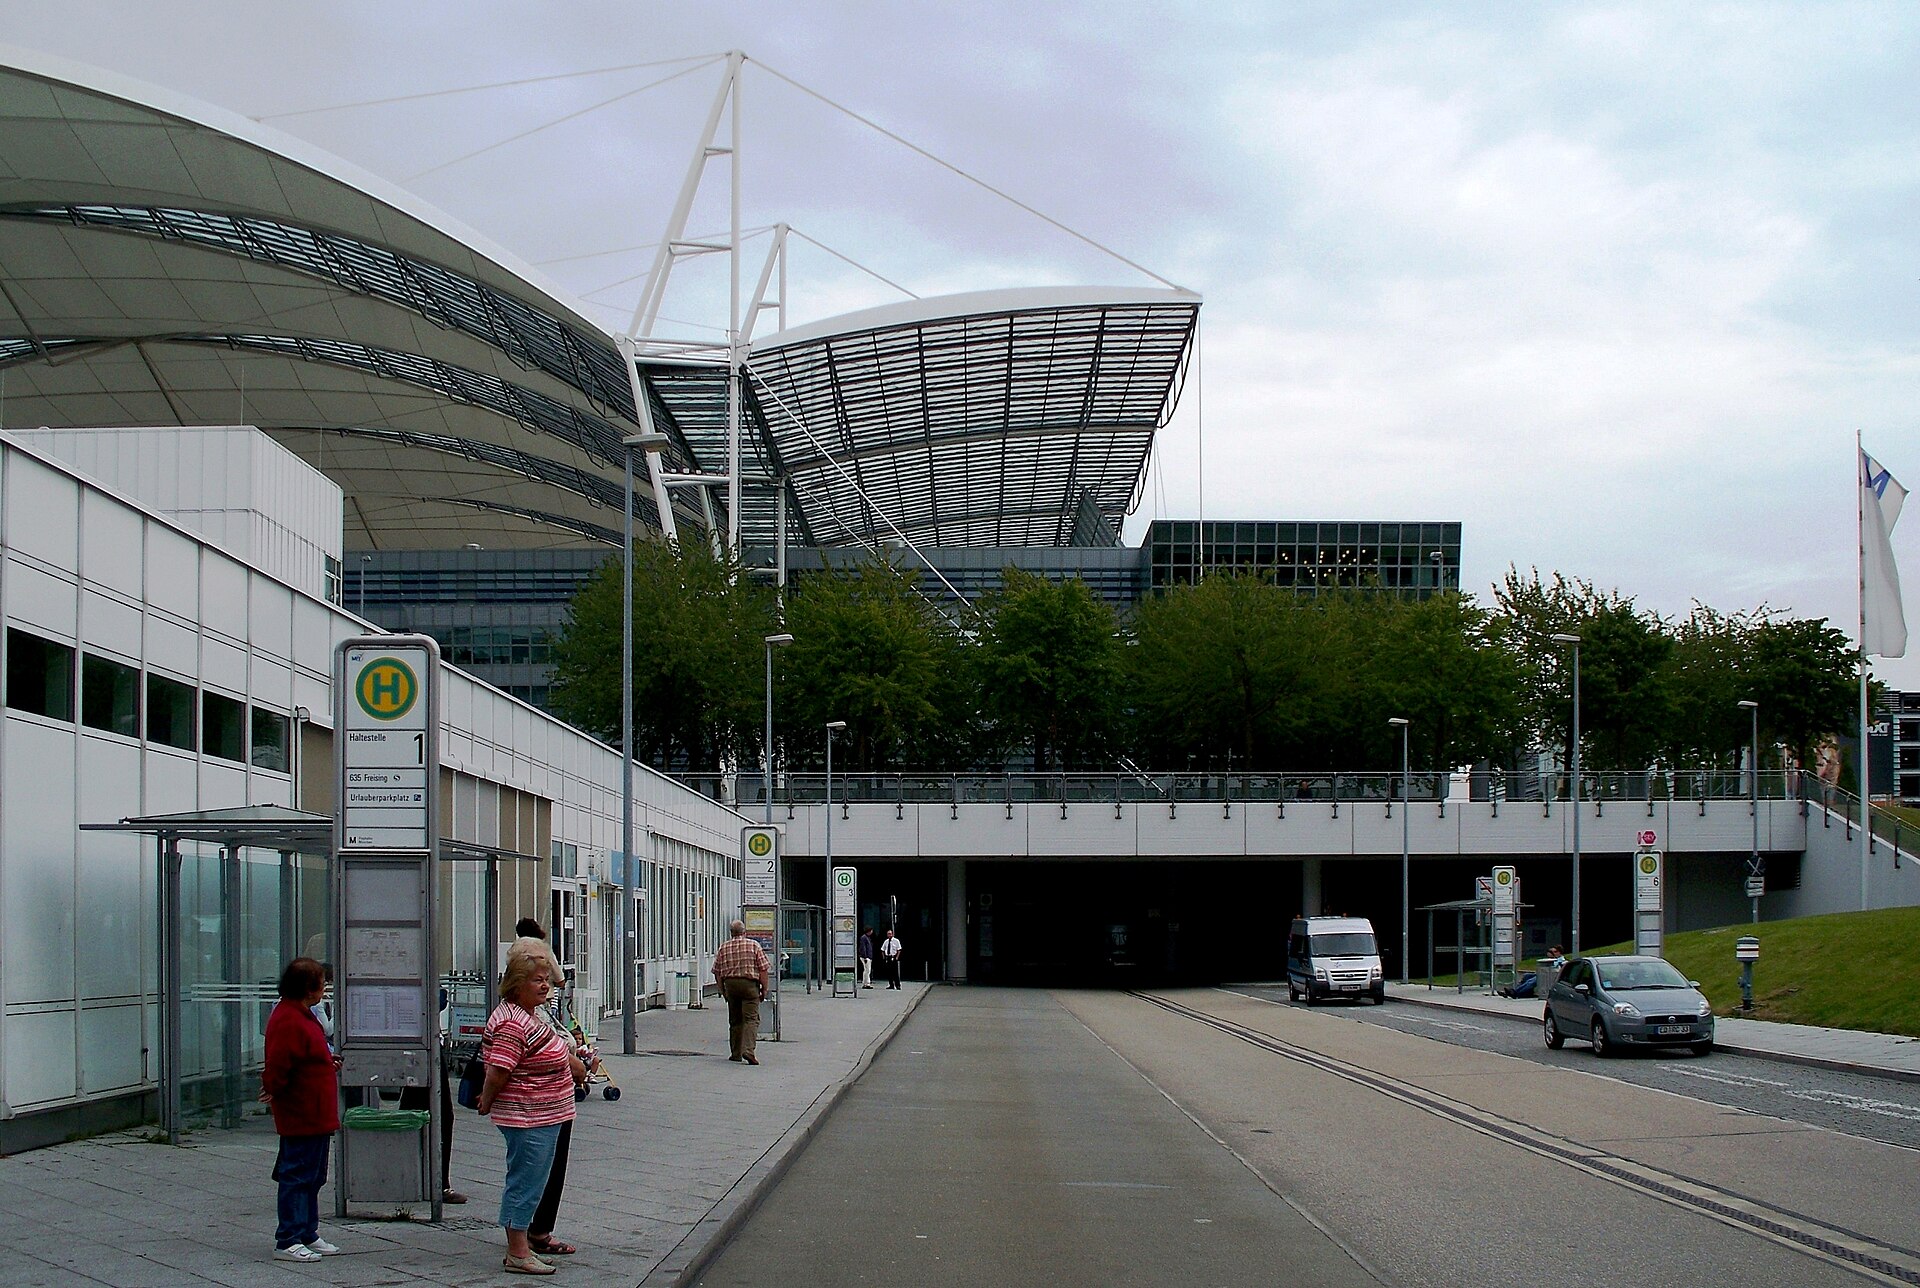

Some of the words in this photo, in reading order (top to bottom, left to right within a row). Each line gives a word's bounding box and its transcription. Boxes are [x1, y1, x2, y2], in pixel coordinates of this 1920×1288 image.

[372, 672, 400, 705] H
[349, 733, 387, 742] Haltestelle
[413, 733, 424, 765] 1
[349, 773, 362, 782] 635
[364, 773, 388, 783] Freising
[350, 793, 410, 803] Urlauberparkplatz
[349, 836, 357, 844] M
[754, 838, 766, 851] H
[767, 860, 775, 873] 2
[1653, 876, 1659, 886] 6
[848, 888, 854, 897] 3
